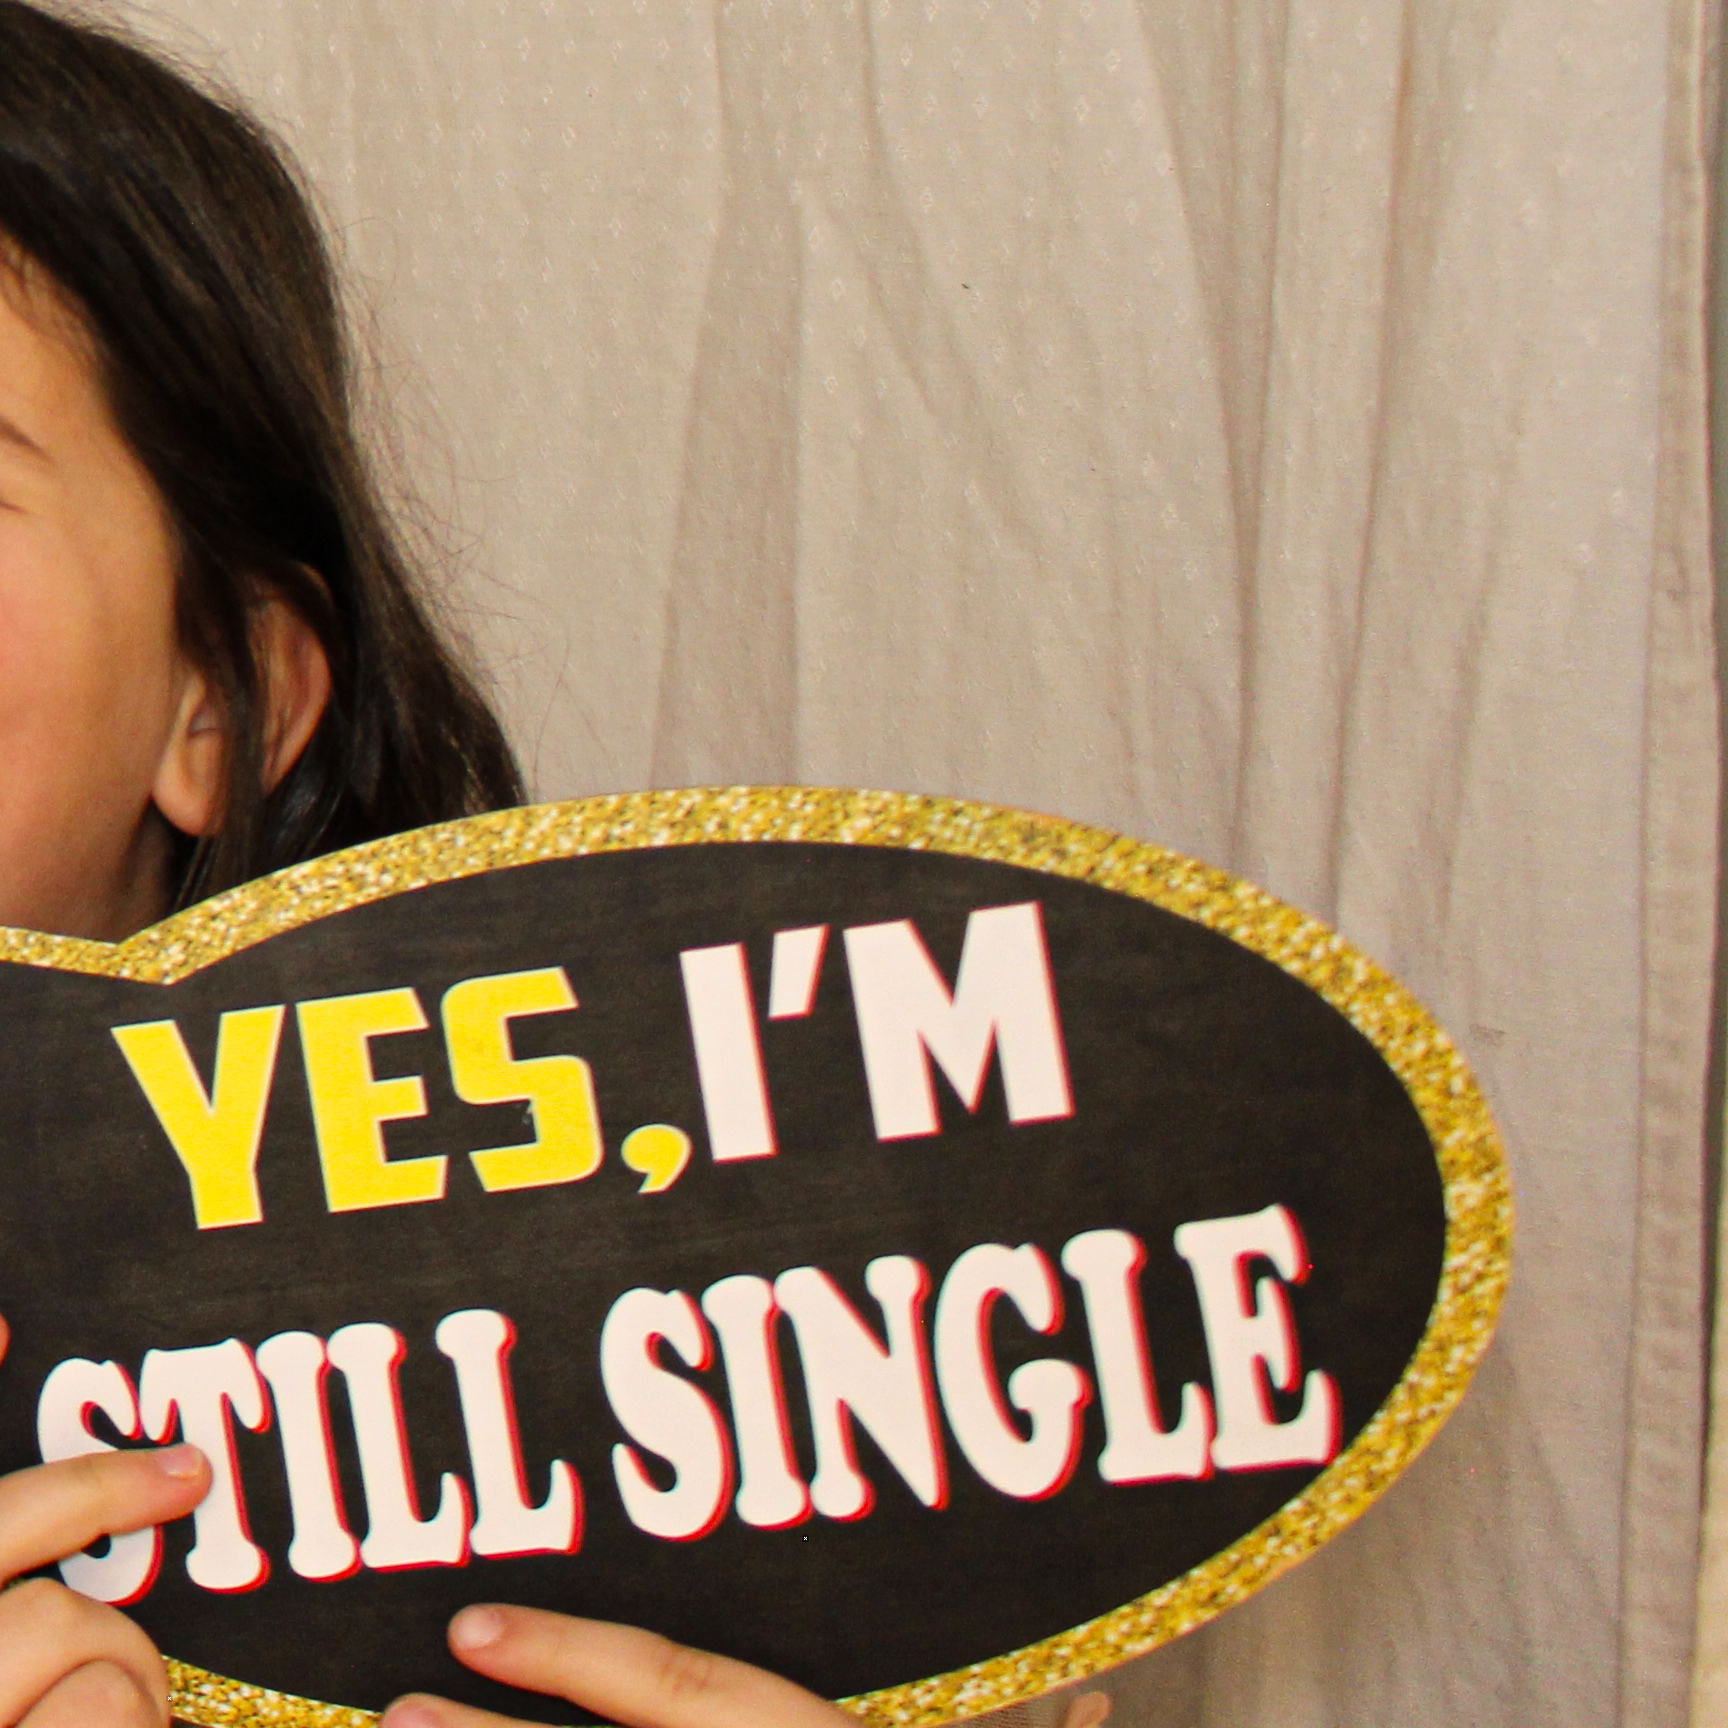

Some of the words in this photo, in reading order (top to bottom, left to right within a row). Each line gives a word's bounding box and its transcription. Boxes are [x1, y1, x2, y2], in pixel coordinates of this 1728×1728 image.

[113, 966, 692, 1229] YES,
[680, 901, 1075, 1162] I'M
[37, 1308, 585, 1607] STILL
[600, 1203, 1343, 1543] SINGLE
